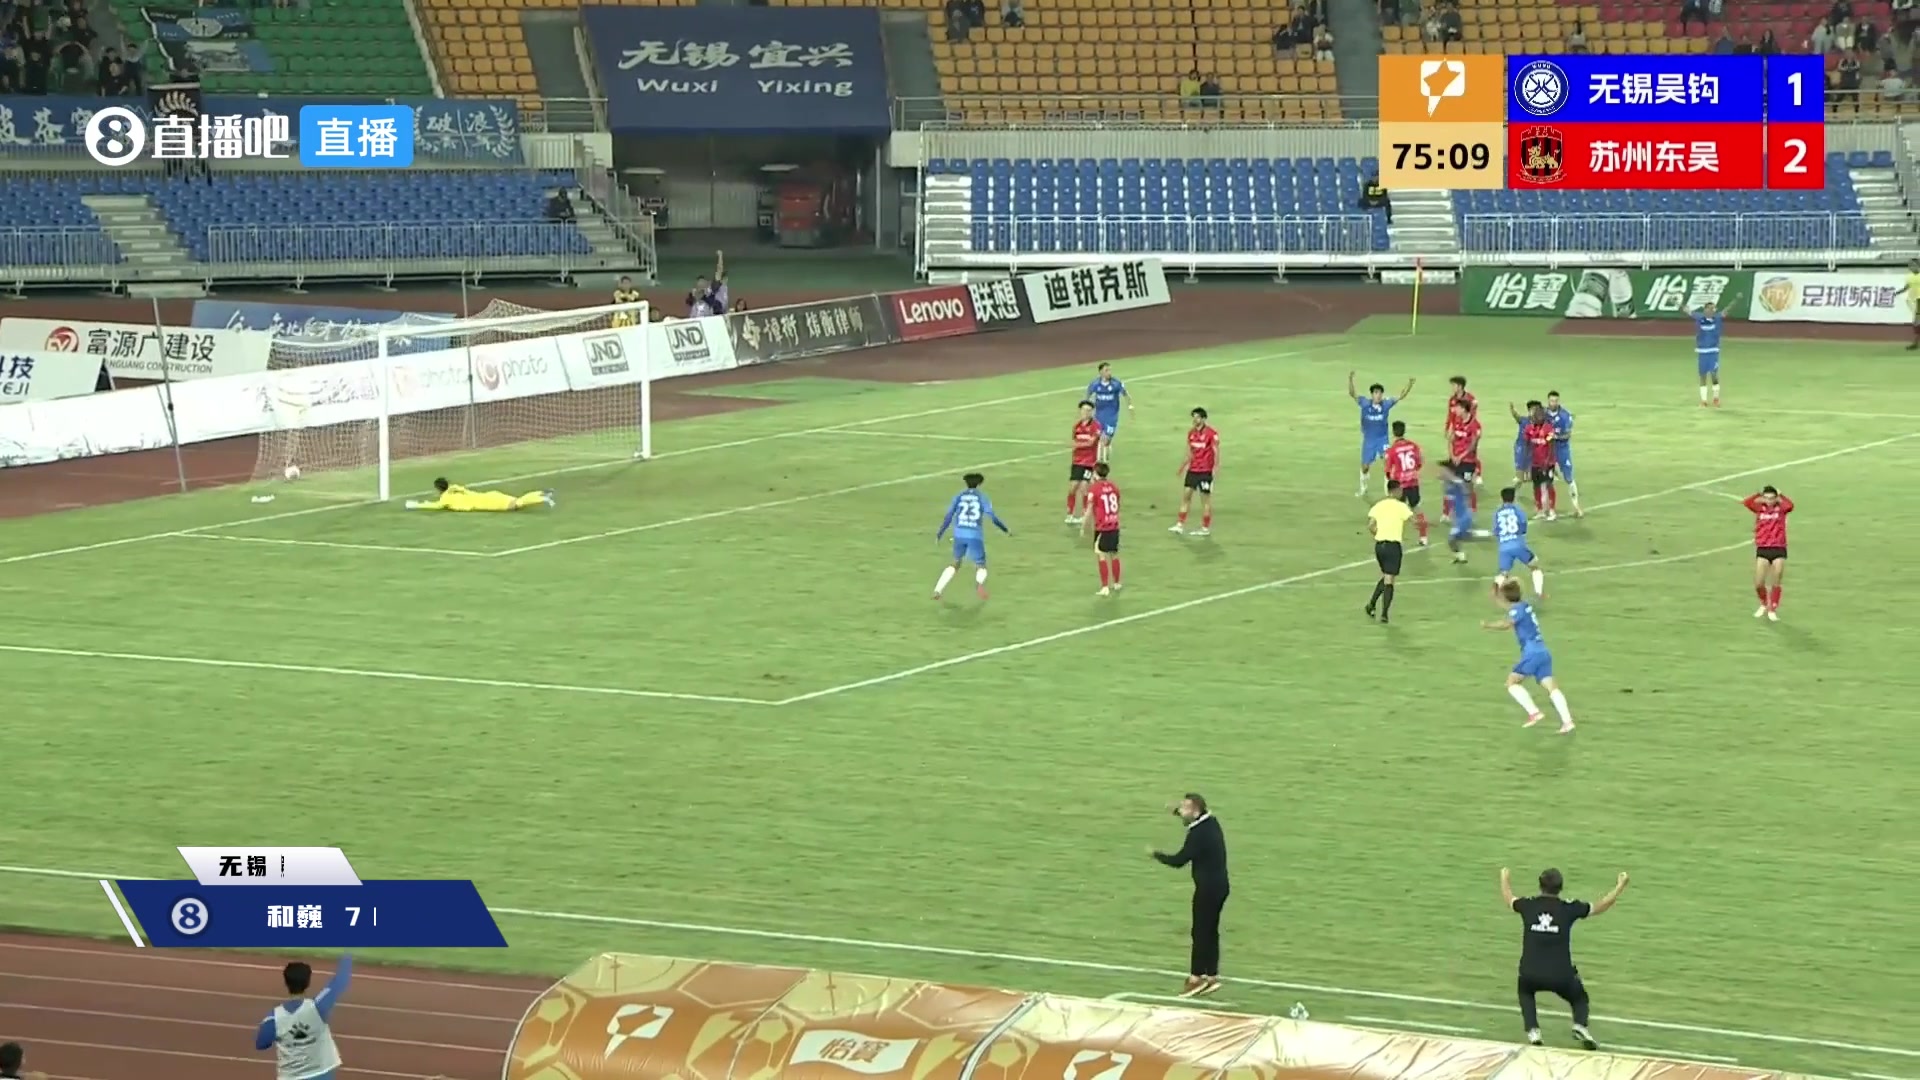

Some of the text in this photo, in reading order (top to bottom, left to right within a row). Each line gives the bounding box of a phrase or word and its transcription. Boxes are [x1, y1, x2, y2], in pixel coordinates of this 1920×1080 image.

[637, 78, 853, 97] Wuxi Yixing
[1044, 261, 1149, 311] 迪锐克斯
[1485, 272, 1568, 310] 怡寶
[1801, 285, 1896, 308] 足球频道
[899, 297, 964, 324] Lenovo
[969, 280, 1021, 323] 联想
[87, 328, 215, 362] 富源广建设
[0, 355, 34, 380] 技
[107, 359, 145, 370] NGUANG
[0, 381, 30, 396] EJI
[1397, 451, 1415, 471] 16
[957, 501, 981, 520] 23
[1100, 493, 1118, 514] 18
[1497, 514, 1519, 536] 38
